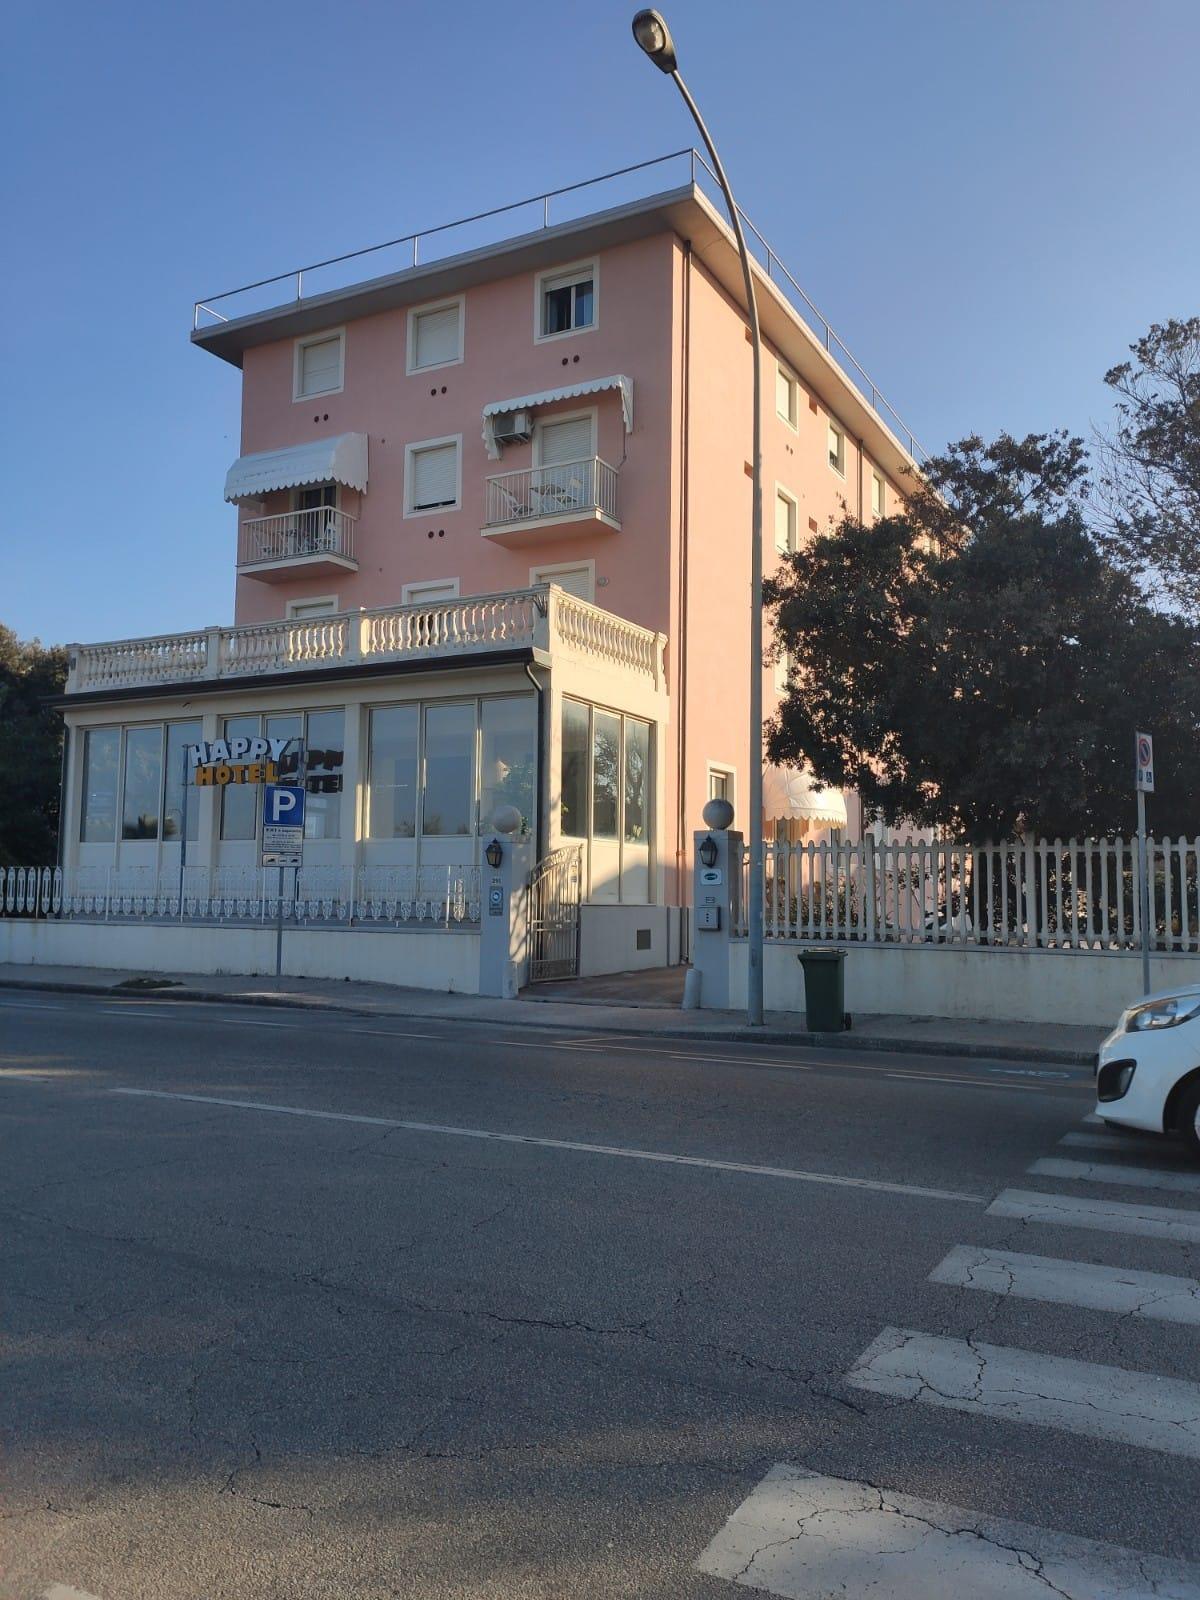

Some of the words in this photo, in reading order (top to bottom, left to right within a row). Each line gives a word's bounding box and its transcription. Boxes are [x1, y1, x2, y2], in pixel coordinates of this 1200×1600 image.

[190, 738, 288, 766] HAPPY
[196, 761, 279, 786] HOTEL
[272, 790, 296, 821] P
